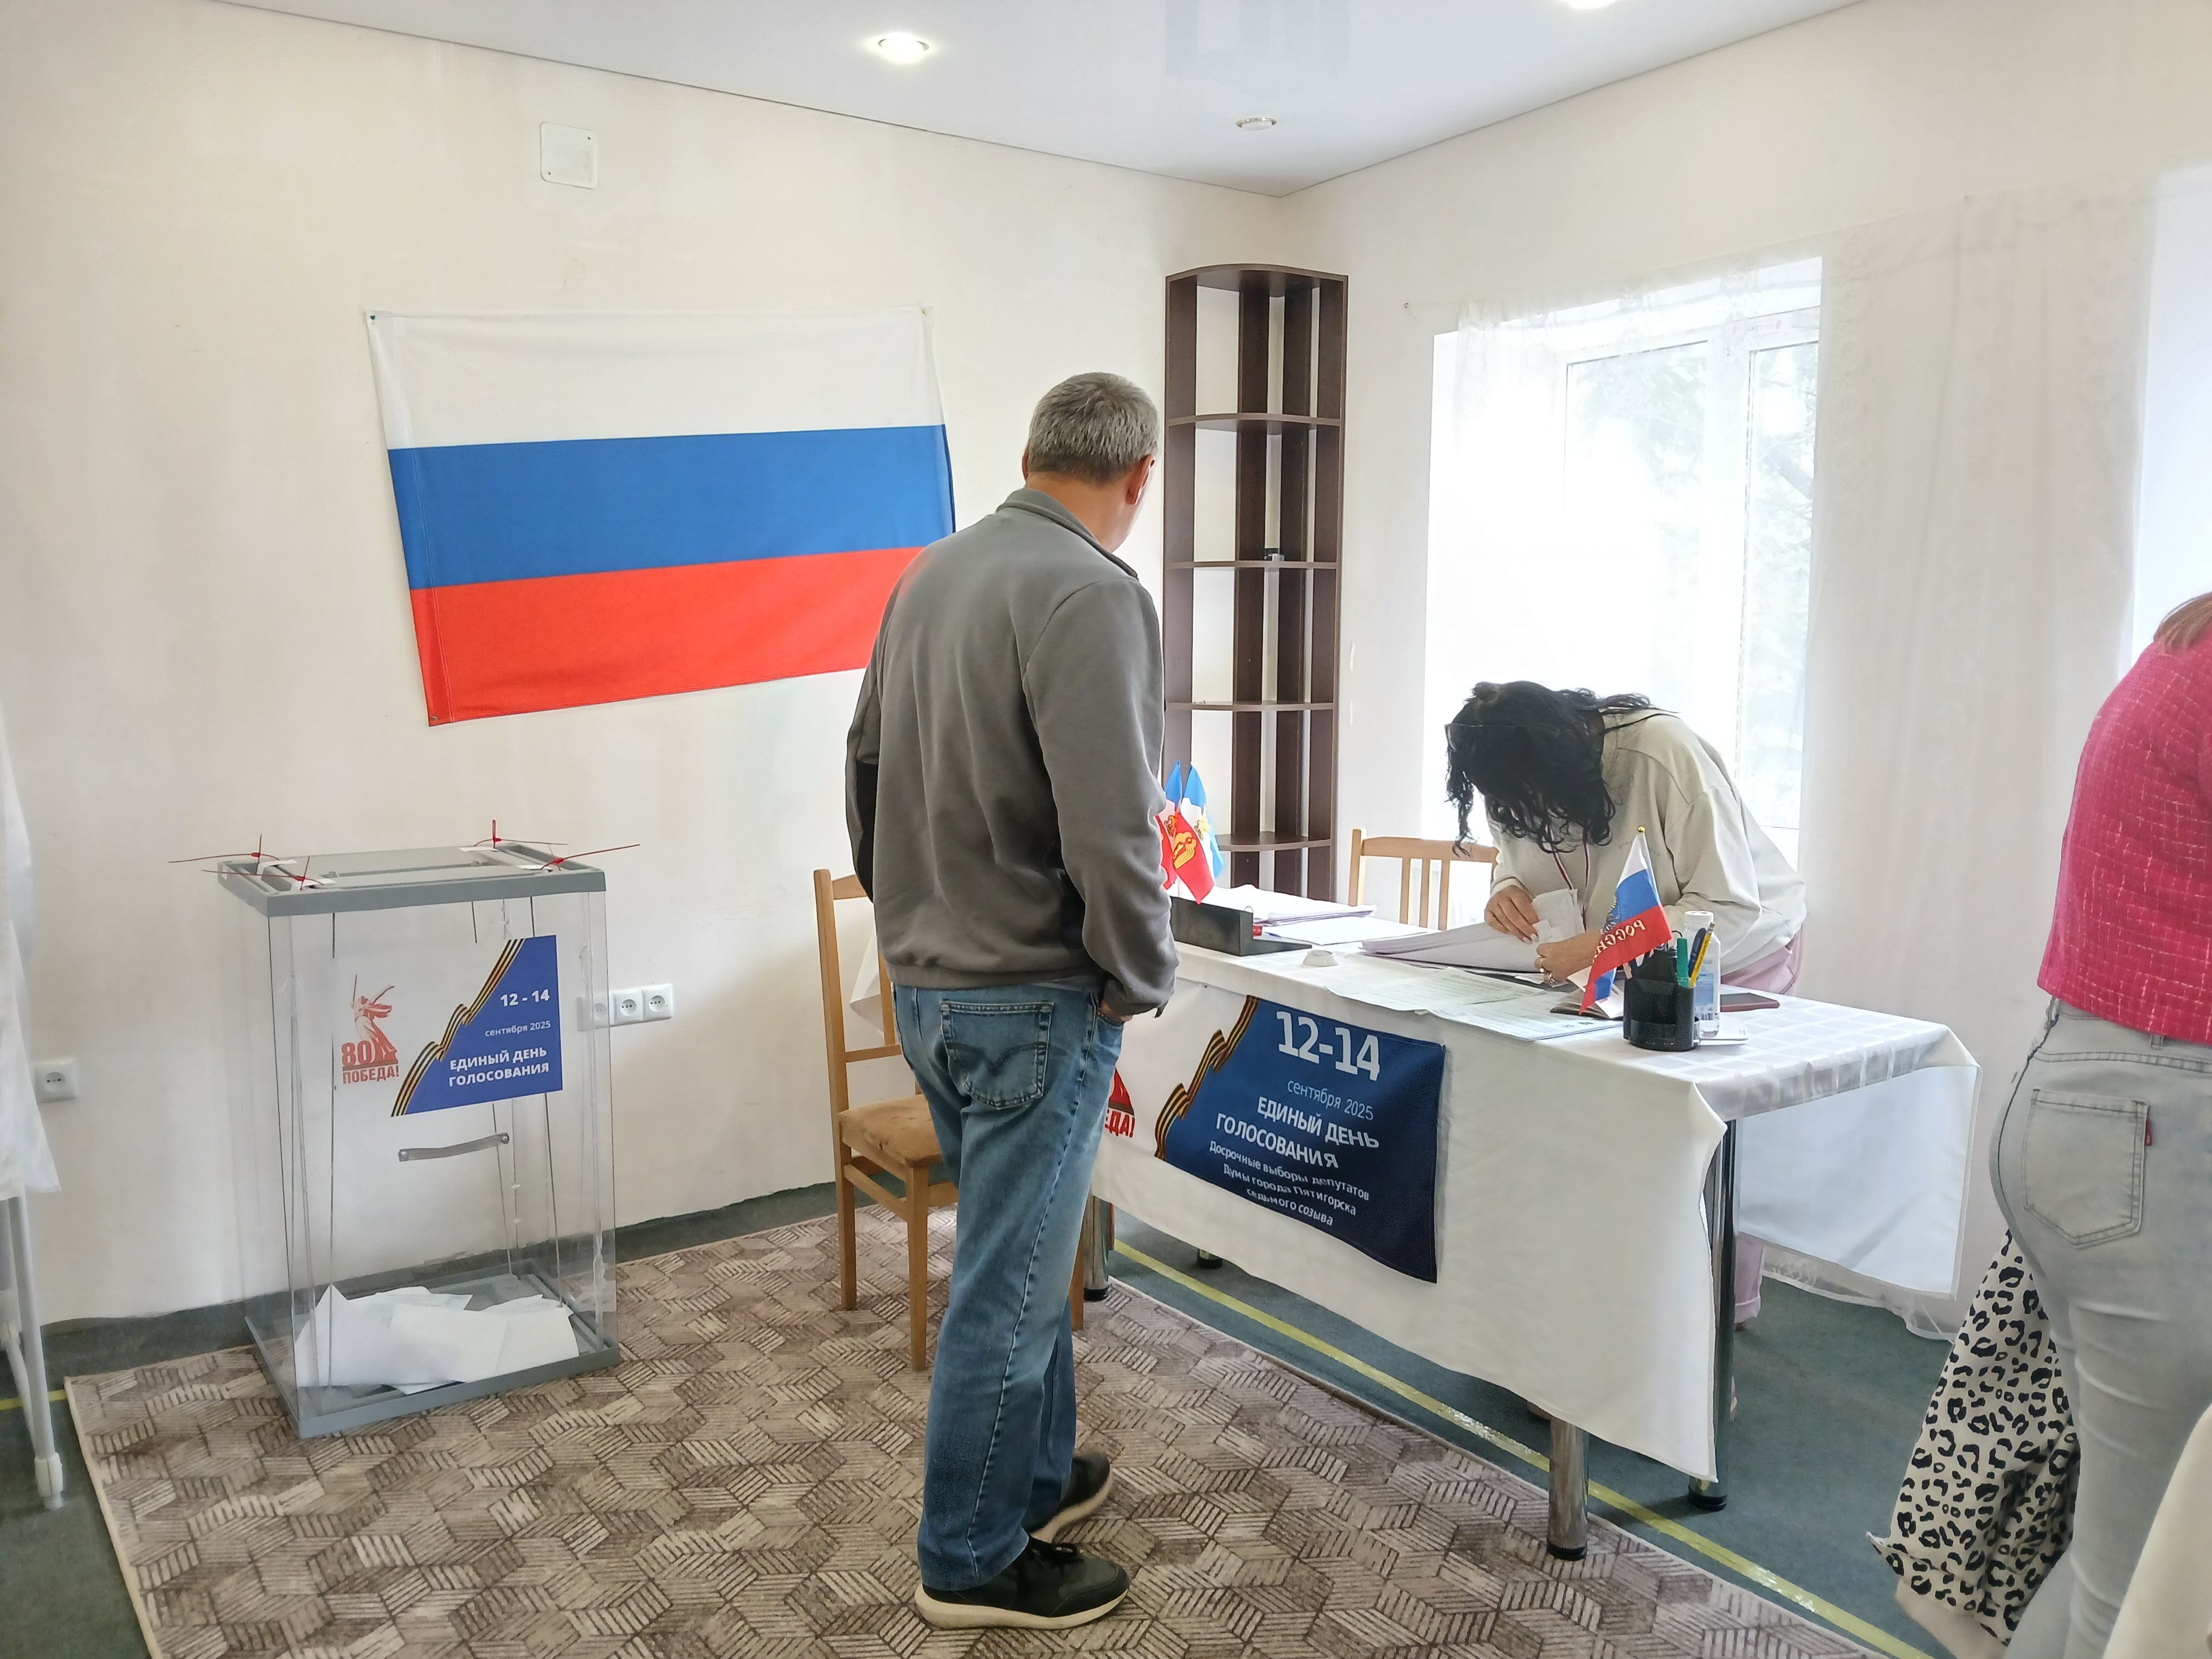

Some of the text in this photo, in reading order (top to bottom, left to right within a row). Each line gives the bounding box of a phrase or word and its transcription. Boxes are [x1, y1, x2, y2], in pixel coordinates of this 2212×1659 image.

[500, 993, 519, 1007] 12
[531, 989, 550, 1003] 14
[485, 1020, 551, 1037] сентября 2025
[1276, 1011, 1380, 1081] 12-14
[342, 1040, 372, 1066] 80
[450, 1047, 548, 1072] ЕДИНЫЙ ДЕНЬ
[342, 1065, 400, 1084] ПОБЕДА!
[449, 1062, 550, 1088] ГОЛОСОВАНИЯ
[1288, 1080, 1374, 1121] сентября 2025
[1216, 1113, 1339, 1168] ГОЛОСОВАНИЯ
[1257, 1096, 1380, 1148] ЕДИНЫЙ ДЕНЬ
[1209, 1140, 1369, 1201] Досрочные выборы депутатов
[1223, 1163, 1356, 1216] Думы города Пятигорска
[1247, 1188, 1334, 1226] седьмого созыва
